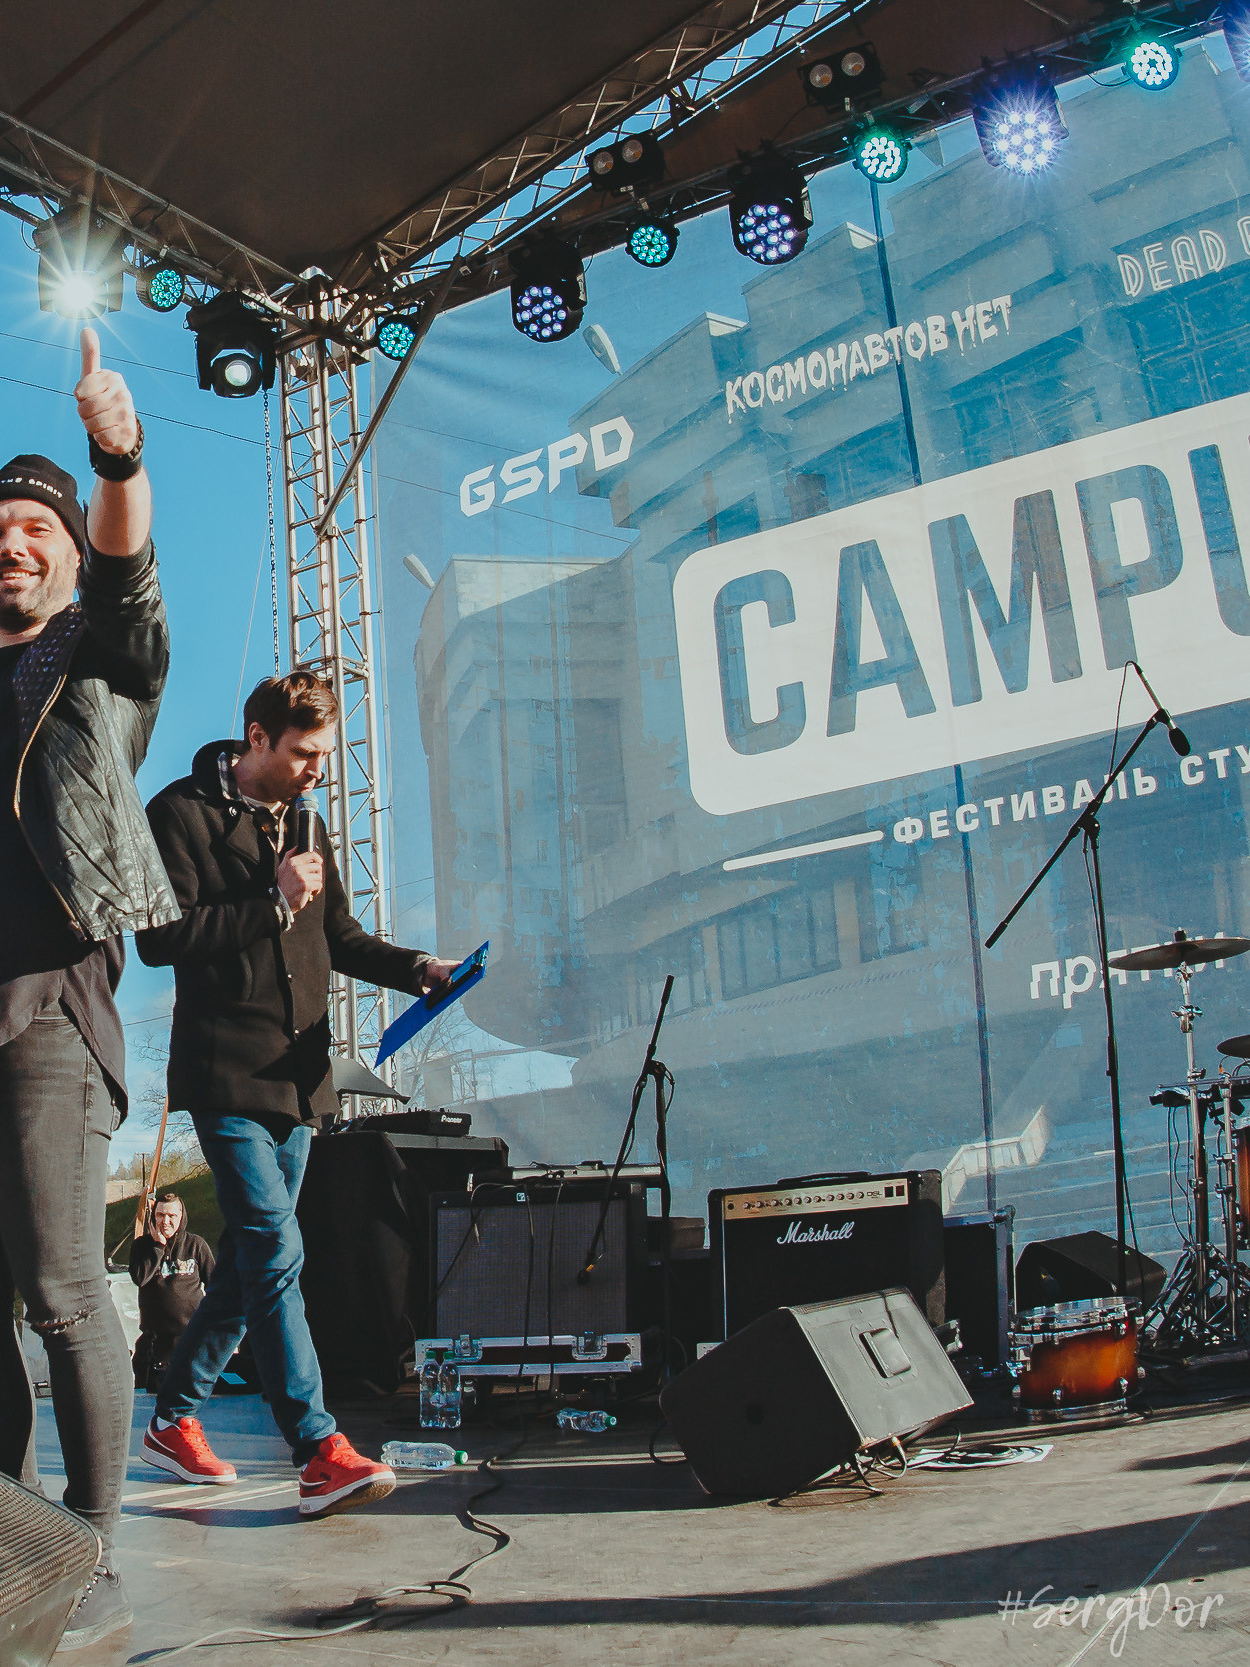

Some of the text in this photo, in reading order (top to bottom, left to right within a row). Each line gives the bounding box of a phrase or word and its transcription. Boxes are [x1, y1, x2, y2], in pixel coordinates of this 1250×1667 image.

[1117, 229, 1226, 297] DEAD
[725, 294, 1012, 424] КОСМОНАВТОВ НЕТ
[460, 415, 634, 517] GSPD
[893, 768, 1158, 844] ФЕСТИВАЛЬ
[777, 1221, 855, 1245] Marshall
